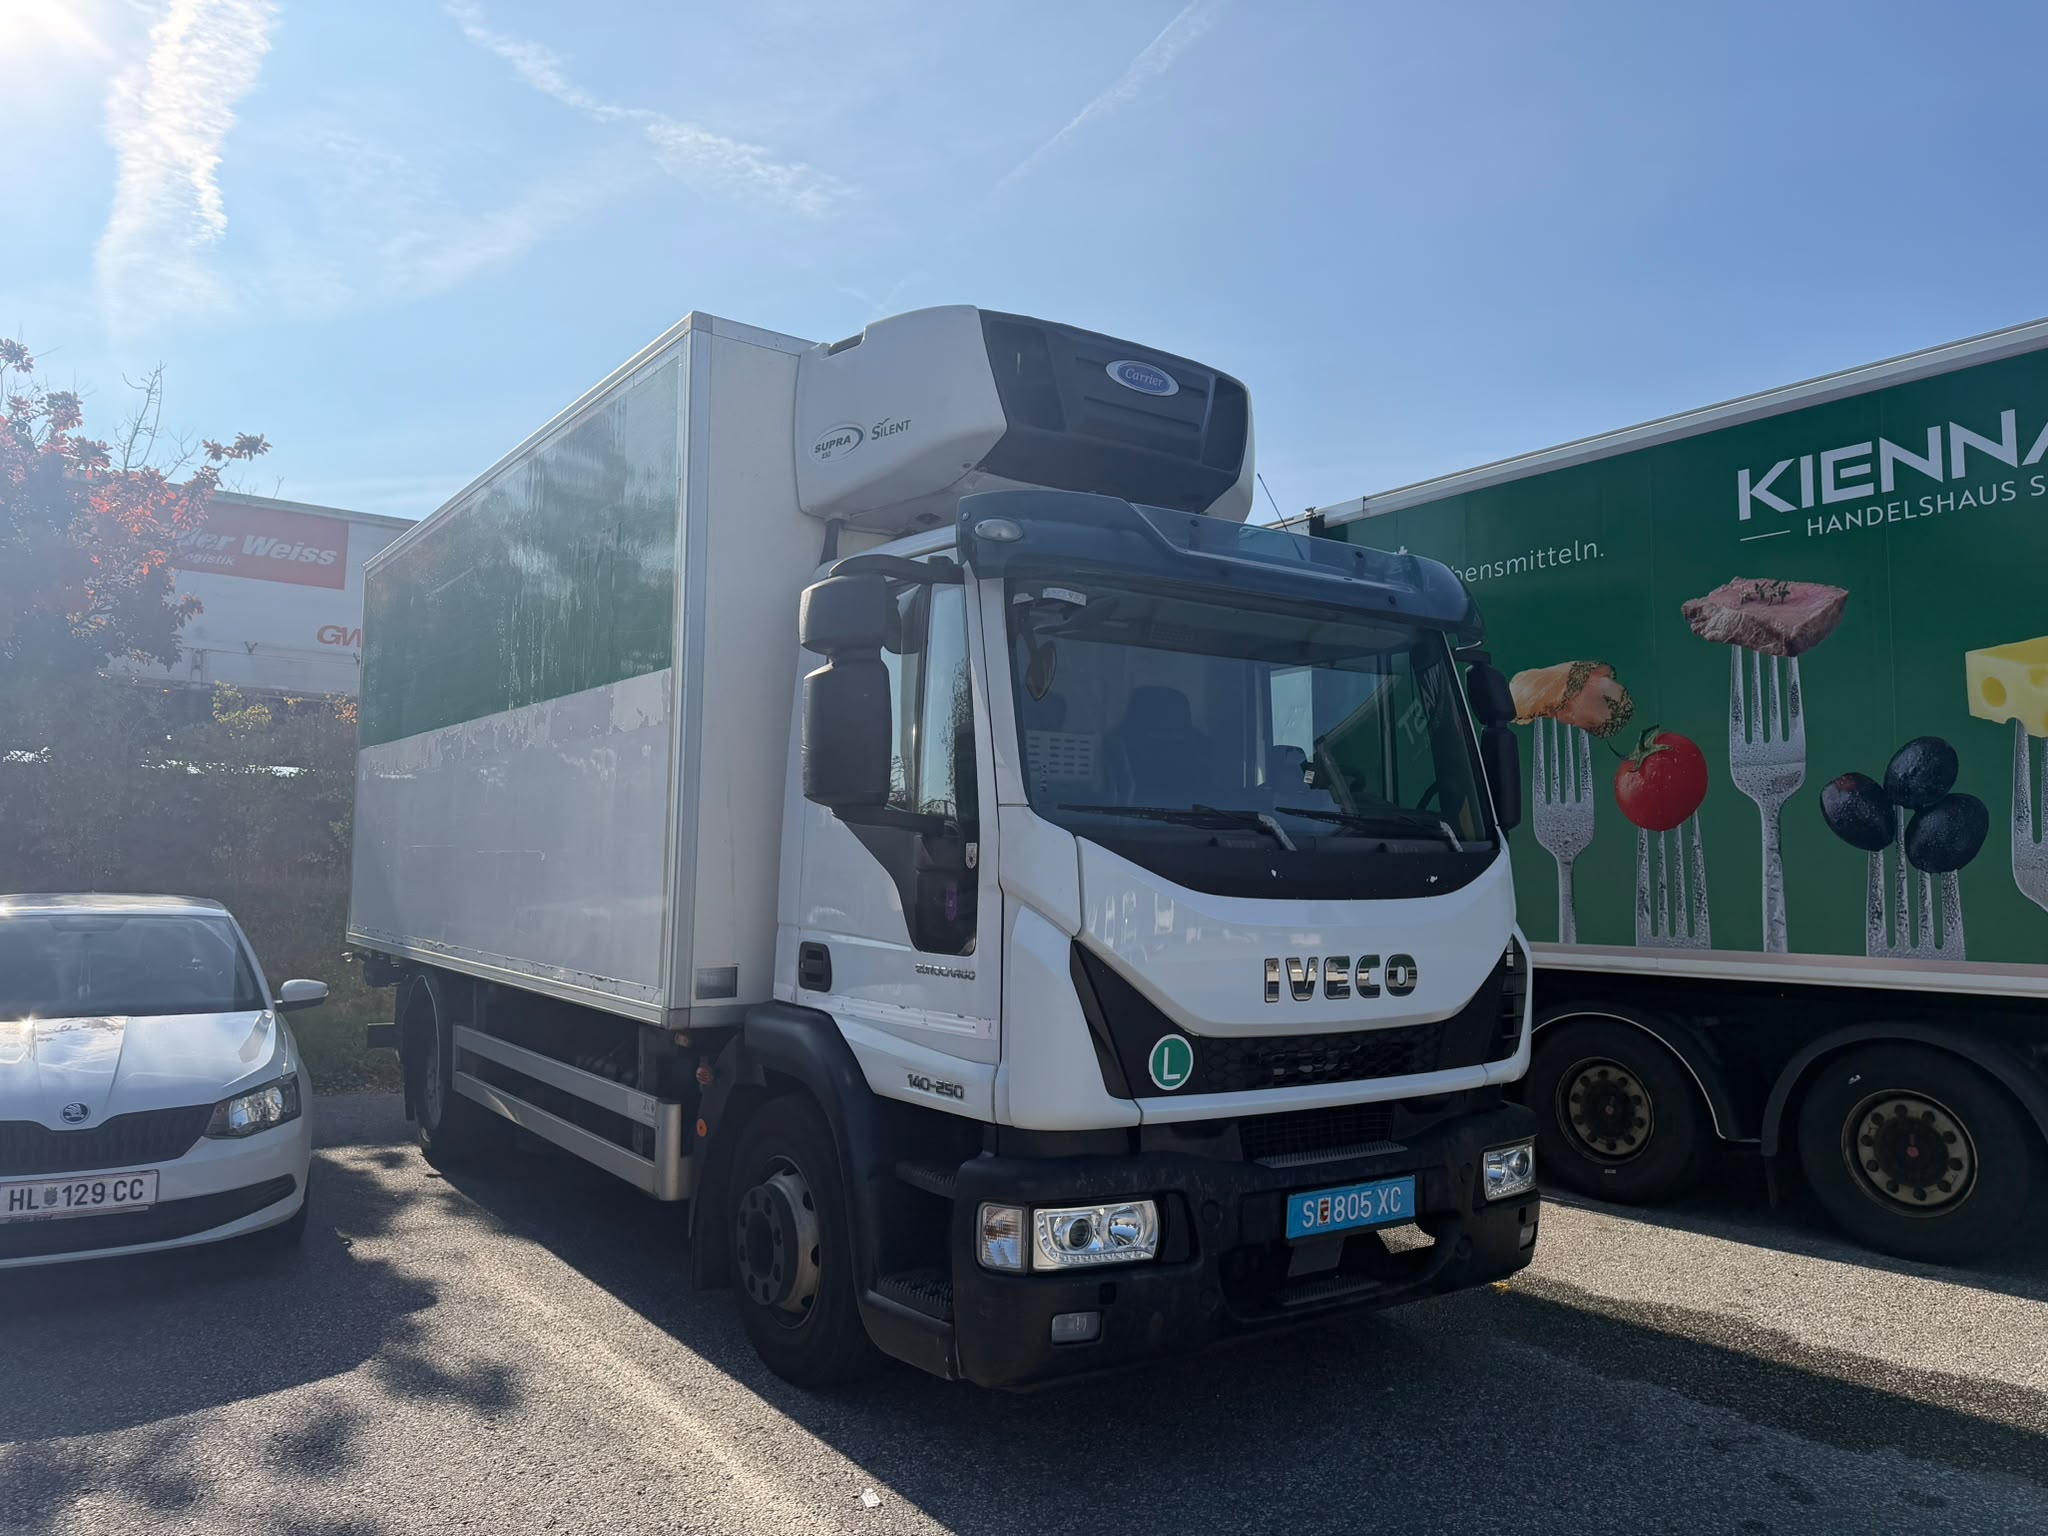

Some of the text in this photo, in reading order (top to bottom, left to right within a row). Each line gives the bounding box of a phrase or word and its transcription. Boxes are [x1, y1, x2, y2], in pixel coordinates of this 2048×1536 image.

[1125, 367, 1164, 387] Carrier
[814, 418, 911, 454] SUPRA SILENT
[1807, 480, 2016, 537] HANDELSHAUS
[242, 533, 337, 565] Weiss
[1264, 953, 1418, 1003] IVECO
[1162, 1046, 1181, 1081] L
[907, 1073, 965, 1100] 140-250
[8, 1178, 144, 1212] HL 129 CC
[1302, 1186, 1401, 1228] S 805 XC
